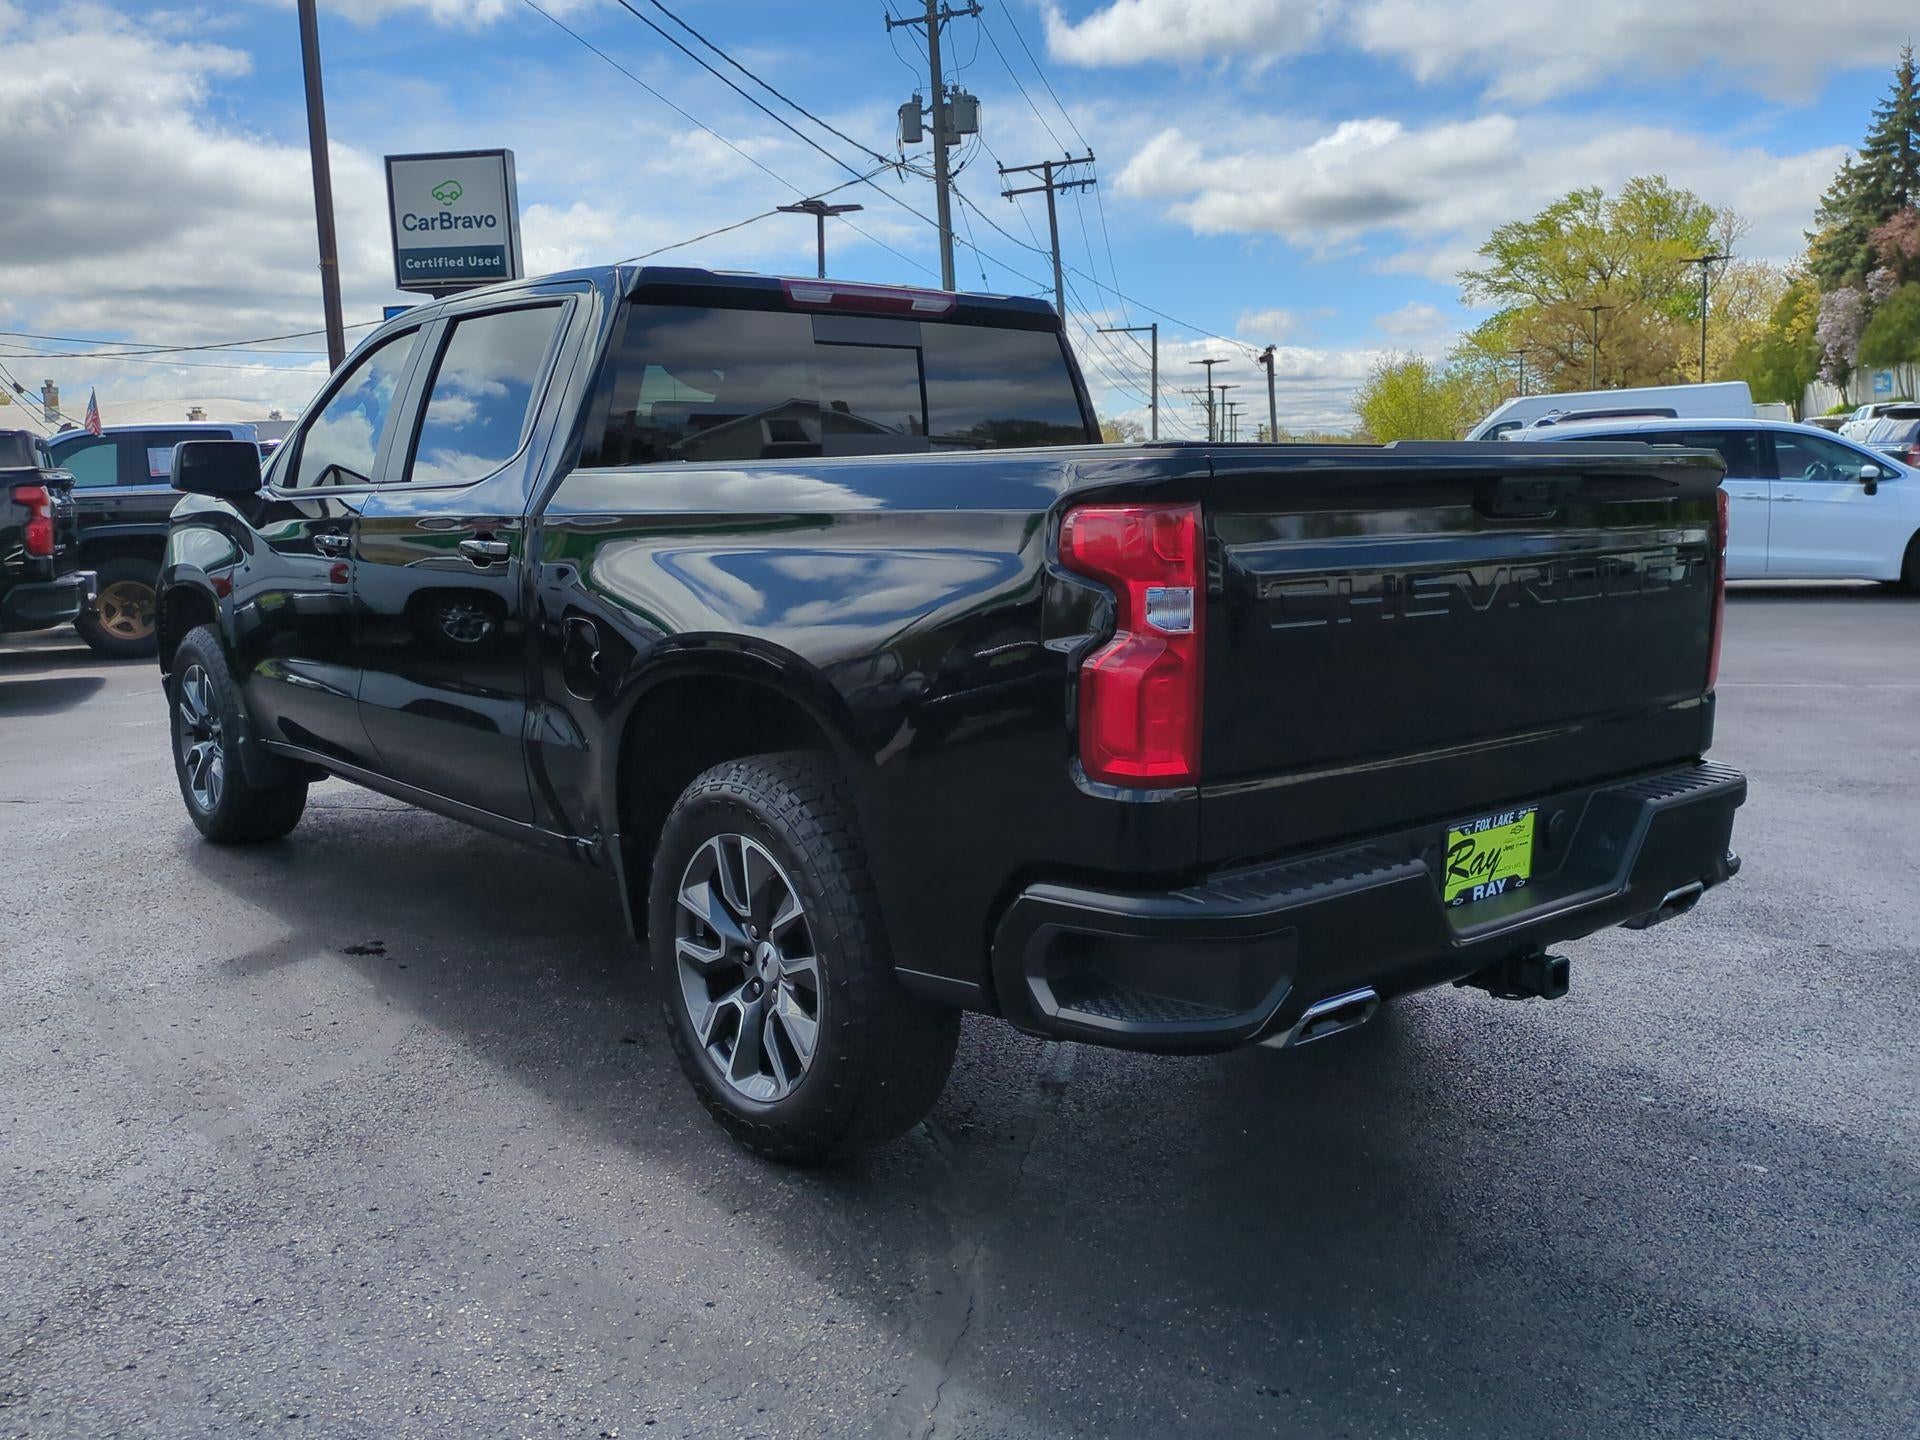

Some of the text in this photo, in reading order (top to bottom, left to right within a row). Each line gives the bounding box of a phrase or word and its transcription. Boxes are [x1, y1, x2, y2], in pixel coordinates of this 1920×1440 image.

[402, 211, 497, 232] CarBravo
[405, 255, 500, 269] Certified Used
[1267, 555, 1705, 629] CHEVROLET
[1474, 817, 1492, 833] FOX
[1492, 811, 1515, 829] LAKE
[1446, 838, 1502, 885] Ray
[1473, 878, 1507, 901] RAY
